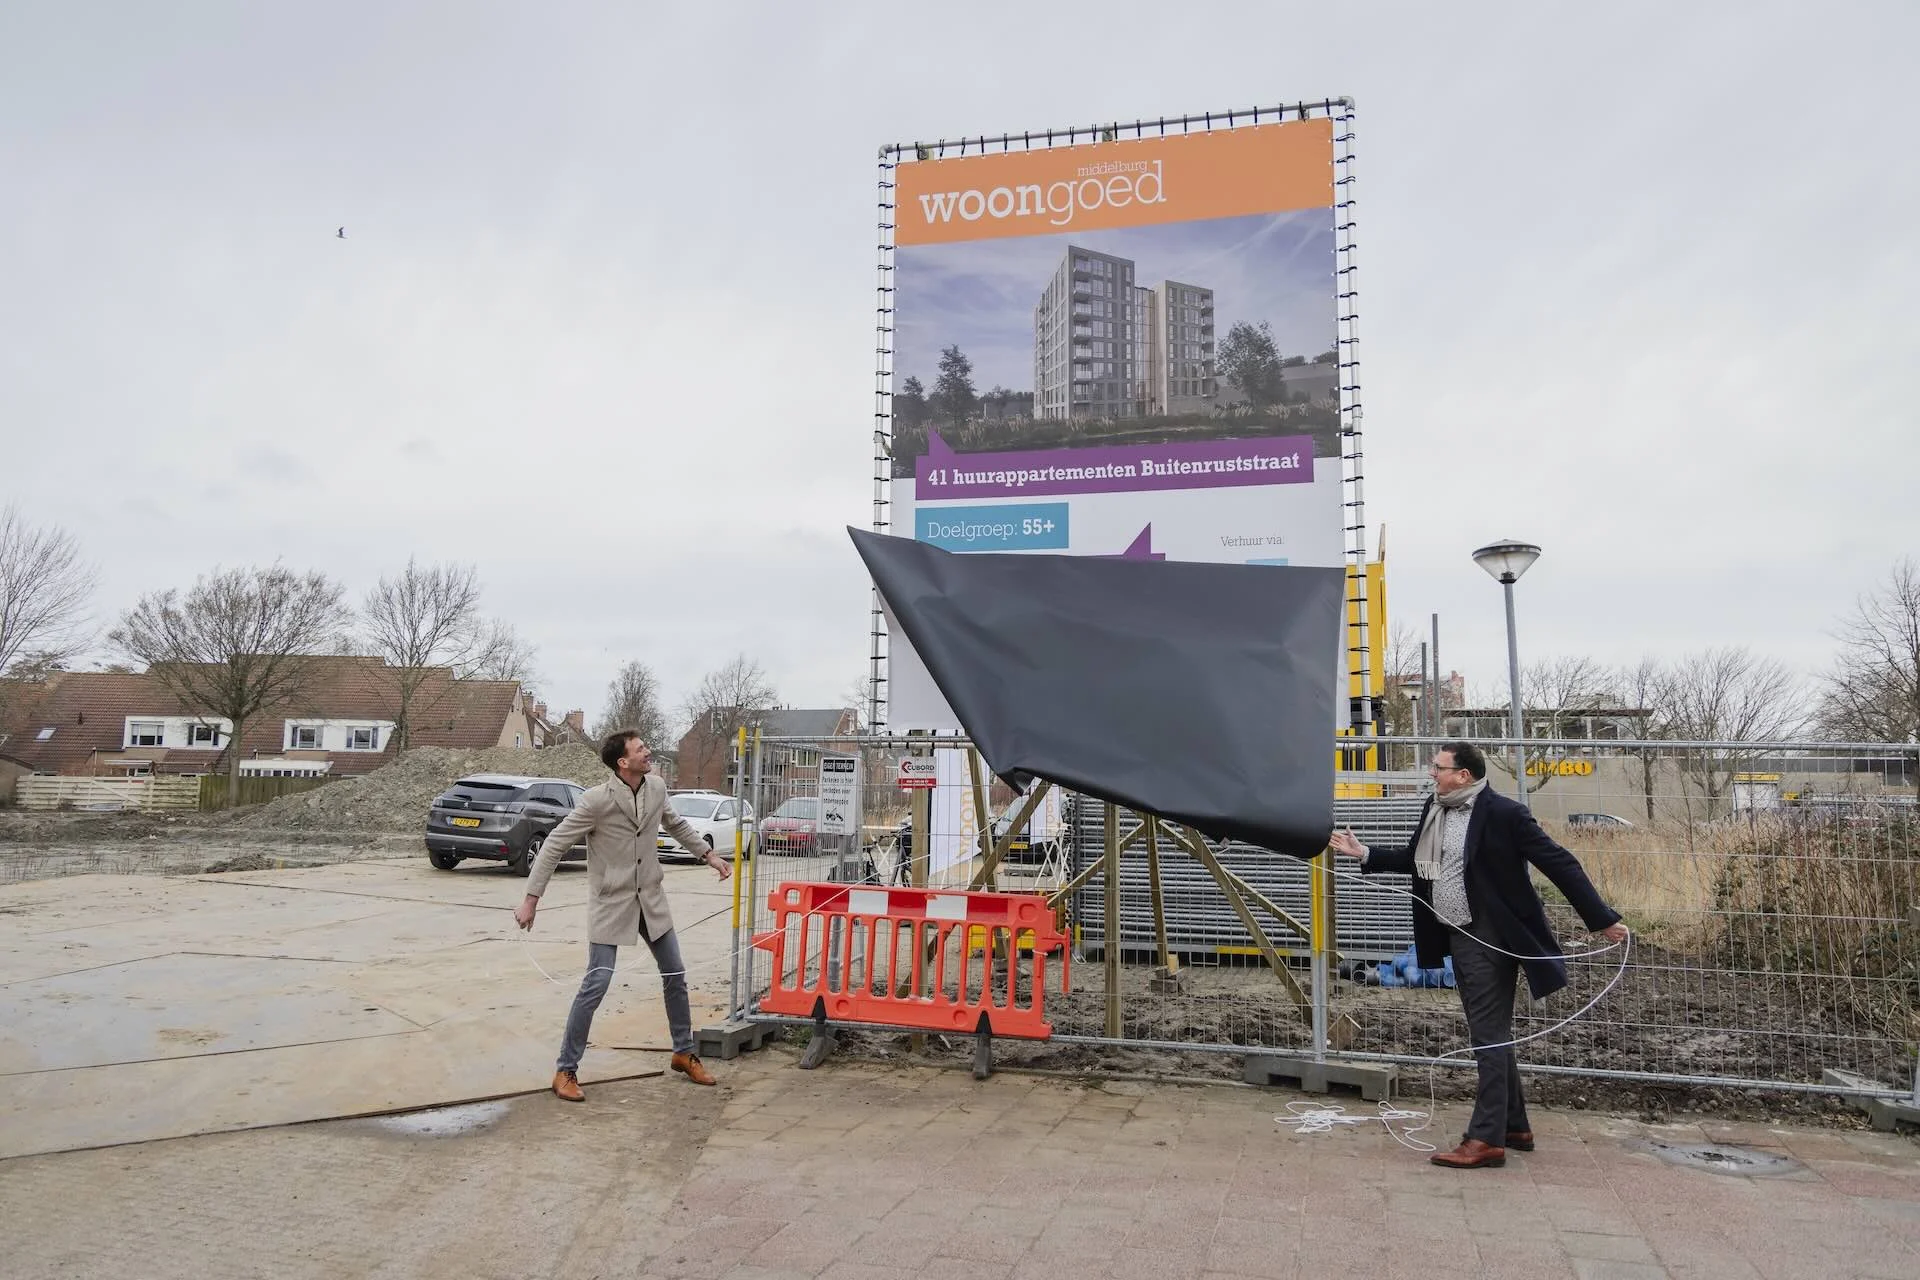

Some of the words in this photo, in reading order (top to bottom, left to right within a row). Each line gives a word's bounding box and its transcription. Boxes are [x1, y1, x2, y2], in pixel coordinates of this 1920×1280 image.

[1078, 160, 1148, 176] middelburg
[919, 159, 1167, 225] woongoed
[928, 469, 947, 486] 41
[953, 463, 1137, 487] huurappartementen
[1141, 452, 1300, 476] Buitenruststraat
[928, 520, 1018, 541] Doelgroep:
[1022, 518, 1055, 535] 55+
[1221, 535, 1264, 547] Verhuur
